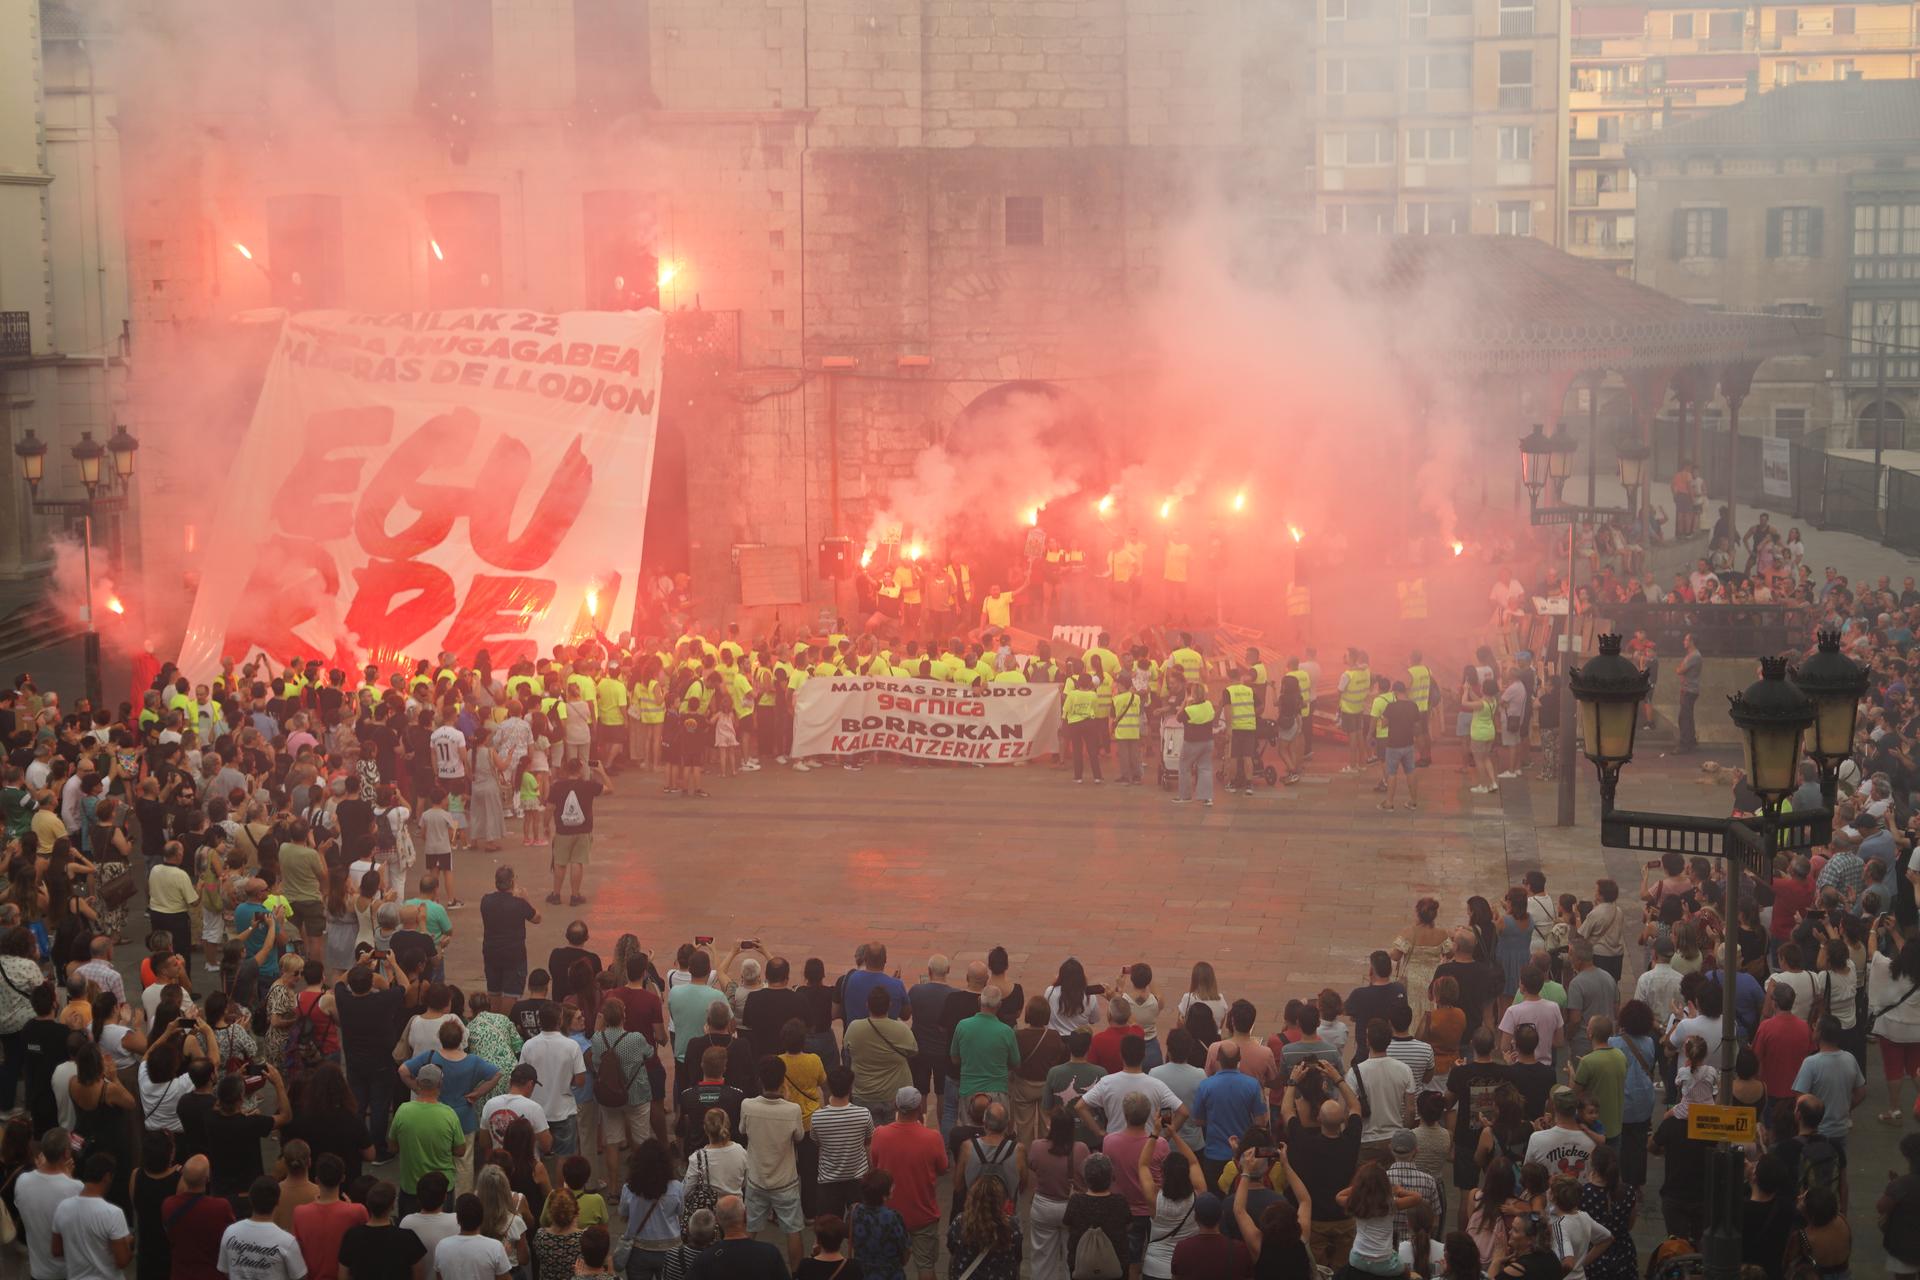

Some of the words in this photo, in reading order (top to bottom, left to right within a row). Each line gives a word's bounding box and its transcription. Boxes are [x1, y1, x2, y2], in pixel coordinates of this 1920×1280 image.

[510, 312, 560, 337] 22
[396, 335, 640, 377] MUGAGABEA
[429, 358, 488, 387] DE
[493, 366, 655, 415] LLODION
[271, 405, 593, 571] EGU
[831, 681, 926, 695] MADERAS
[931, 687, 957, 698] DE
[877, 693, 985, 717] garnica
[841, 716, 1023, 740] BORROKAN
[831, 732, 993, 759] KALERATZERIK
[998, 741, 1033, 758] EZ!
[1546, 1144, 1590, 1162] Mickey
[226, 1235, 280, 1257] Originals
